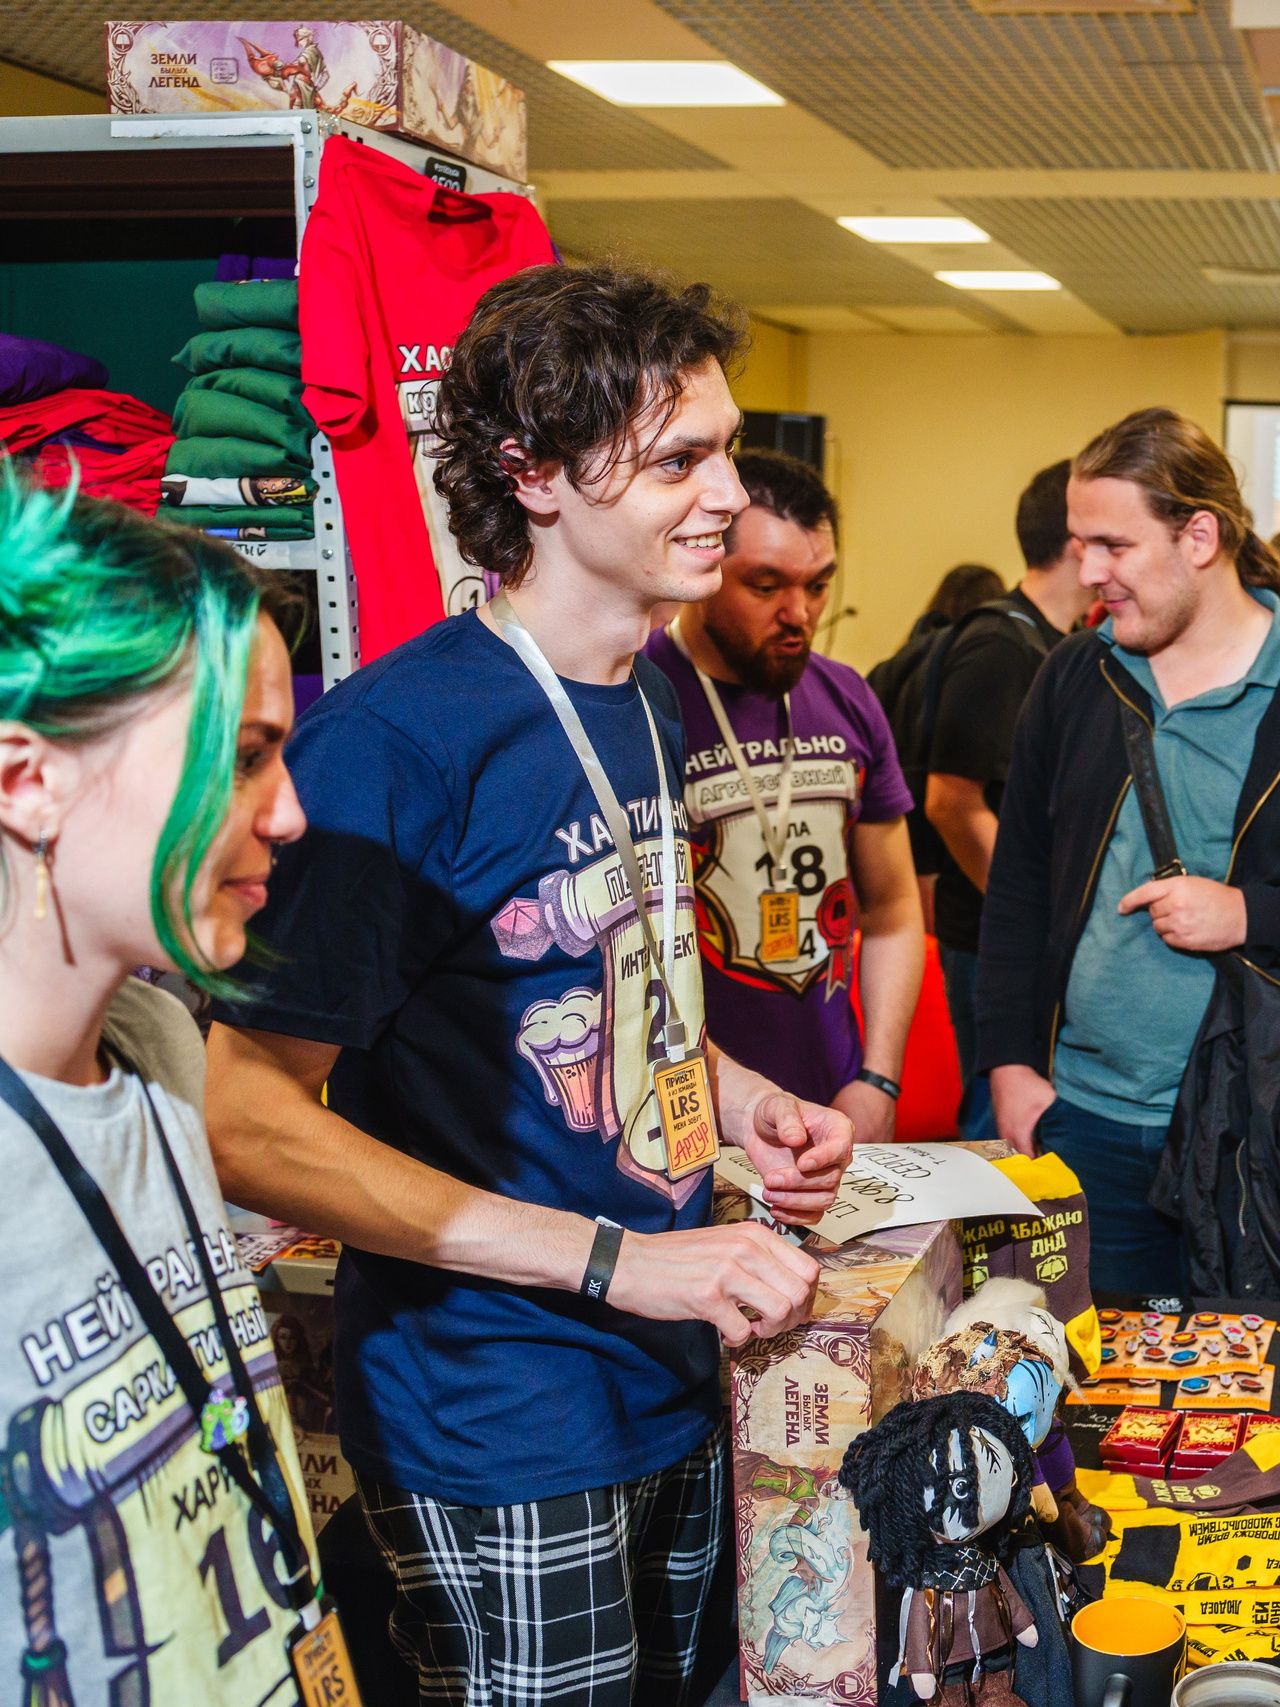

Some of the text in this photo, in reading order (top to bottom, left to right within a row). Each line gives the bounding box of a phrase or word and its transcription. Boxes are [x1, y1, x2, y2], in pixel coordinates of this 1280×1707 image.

[150, 53, 198, 65] ЗЕМЛИ
[148, 76, 202, 88] ЛЕГЕНД
[665, 1068, 696, 1090] ПРИВЕТ!
[670, 1091, 700, 1120] LRS
[673, 1121, 687, 1132] МЕНЯ
[674, 1121, 710, 1168] АРТУР
[1030, 1231, 1067, 1258] ДНД
[785, 1375, 800, 1448] ЛЕГЕНД
[803, 1394, 812, 1432] БЫЛЫХ
[814, 1382, 830, 1446] ЗЕМЛИ
[1188, 1516, 1273, 1538] УДОВОЛЬСТВИЕМ
[1197, 1530, 1280, 1546] ПРОВОЖУ ВРЕМЯ
[1200, 1599, 1243, 1615] ЛЮДОЕД
